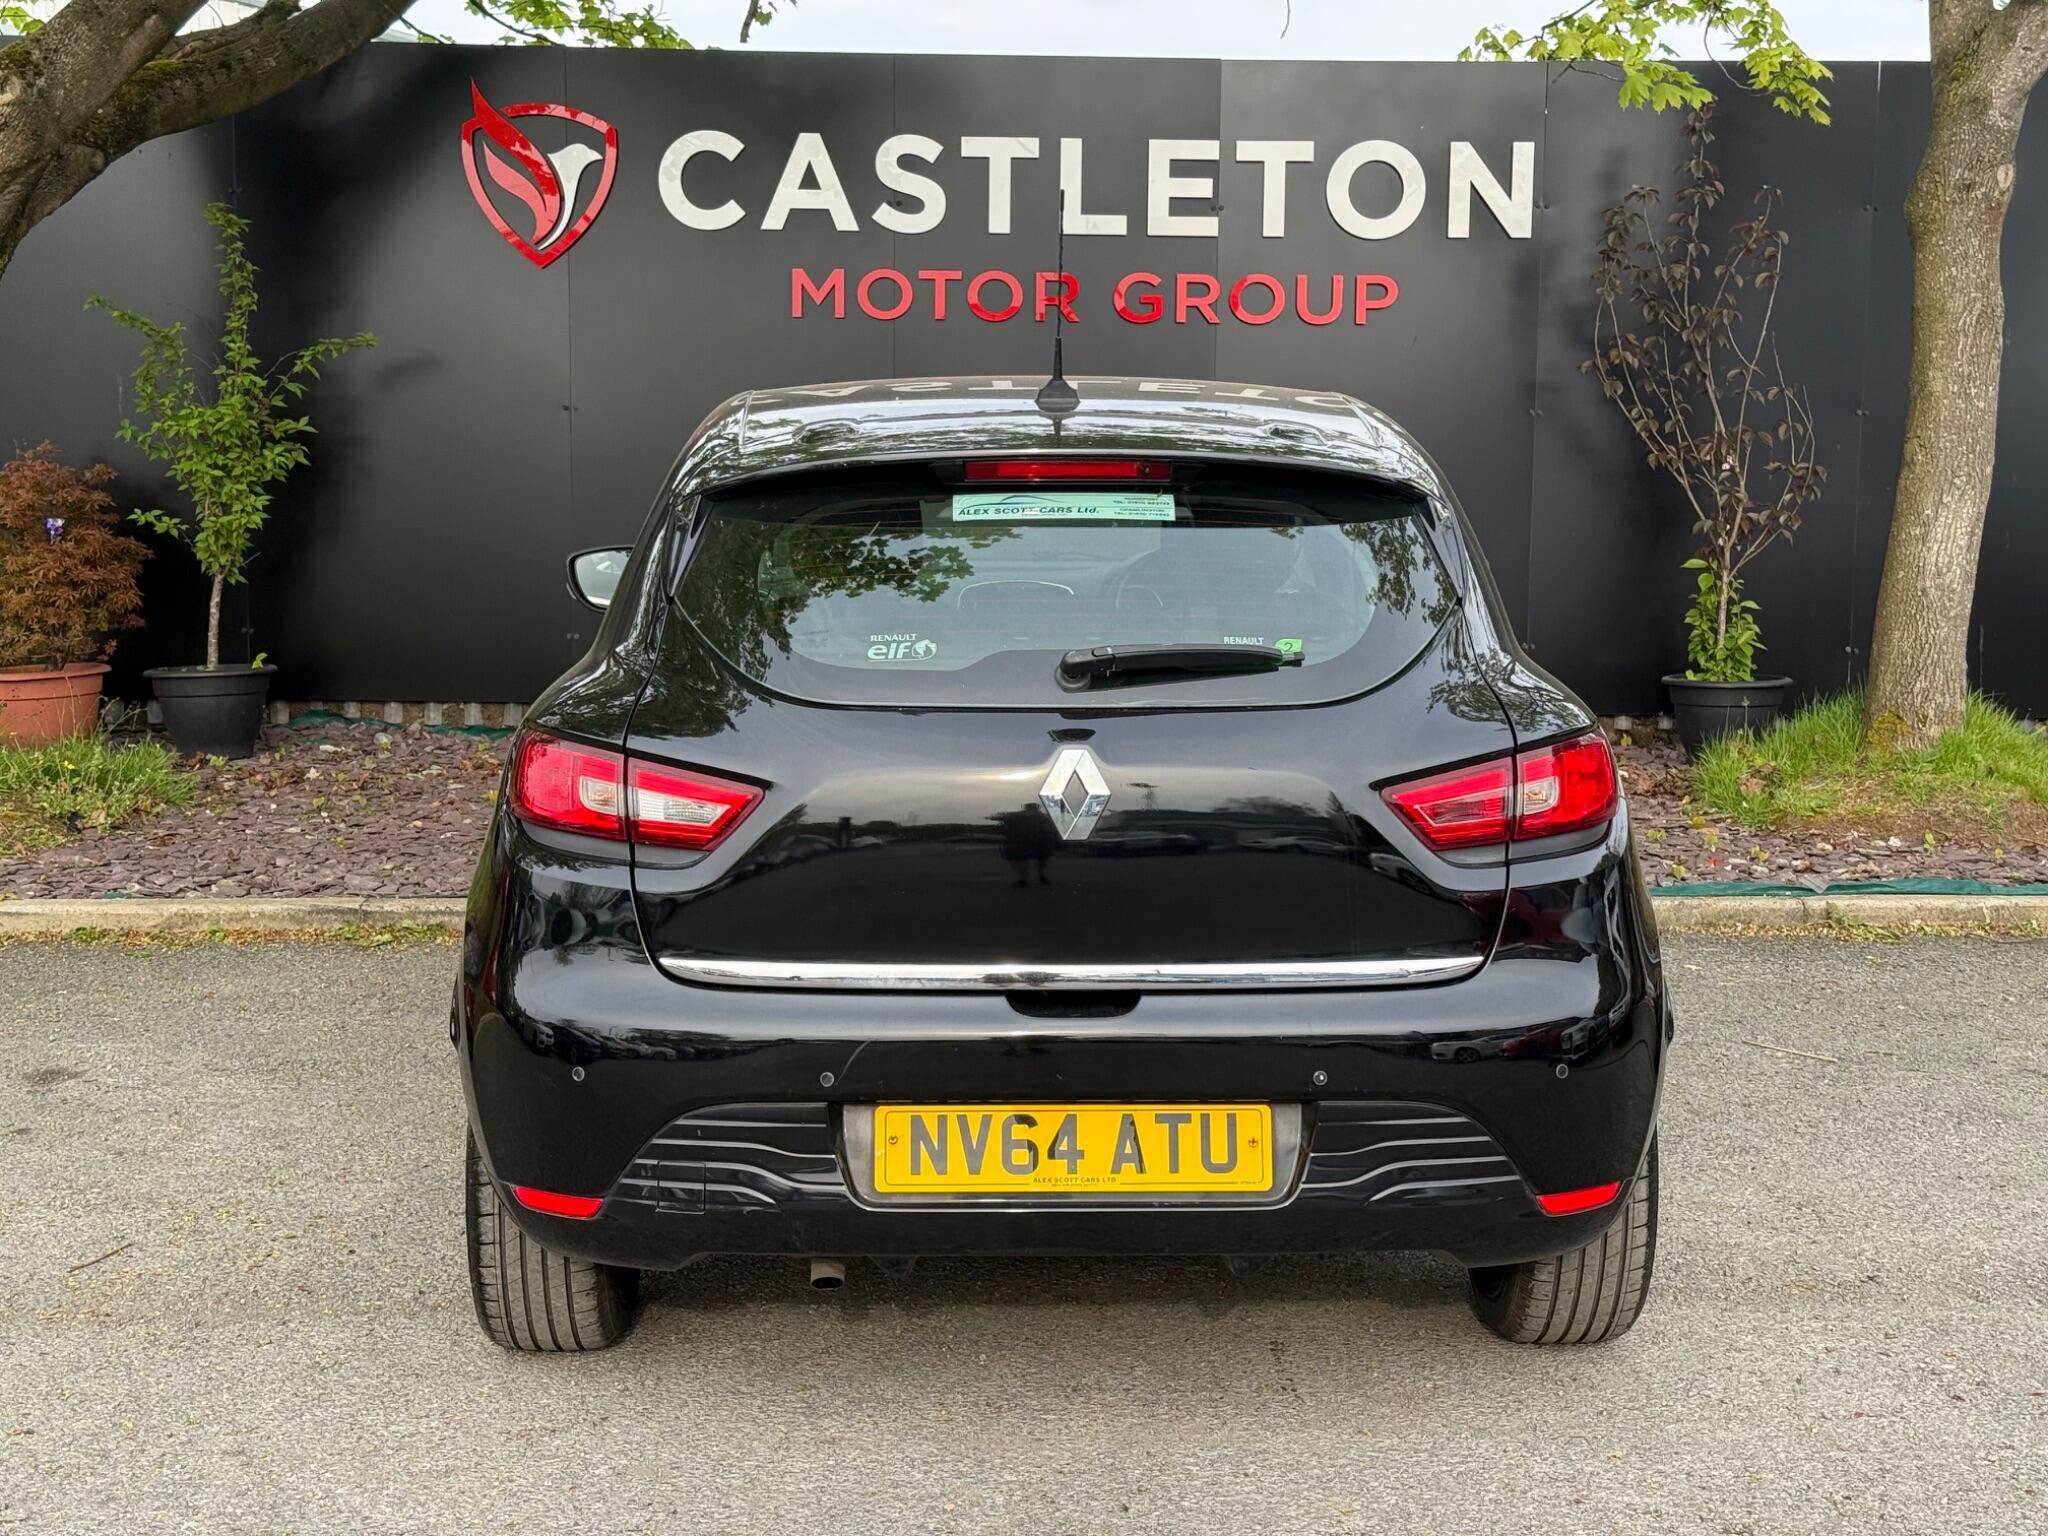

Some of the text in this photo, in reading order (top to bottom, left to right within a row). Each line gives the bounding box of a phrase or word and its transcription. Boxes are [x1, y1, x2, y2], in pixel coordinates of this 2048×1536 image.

[658, 130, 1536, 239] CASTLETON
[791, 267, 1399, 326] MOTOR GROUP
[958, 508, 990, 516] ALEX
[1039, 506, 1073, 514] CARS
[870, 633, 918, 642] RENAULT
[1223, 636, 1264, 645] RENAULT
[867, 642, 912, 660] elf
[909, 1112, 1239, 1176] NV64 ATU
